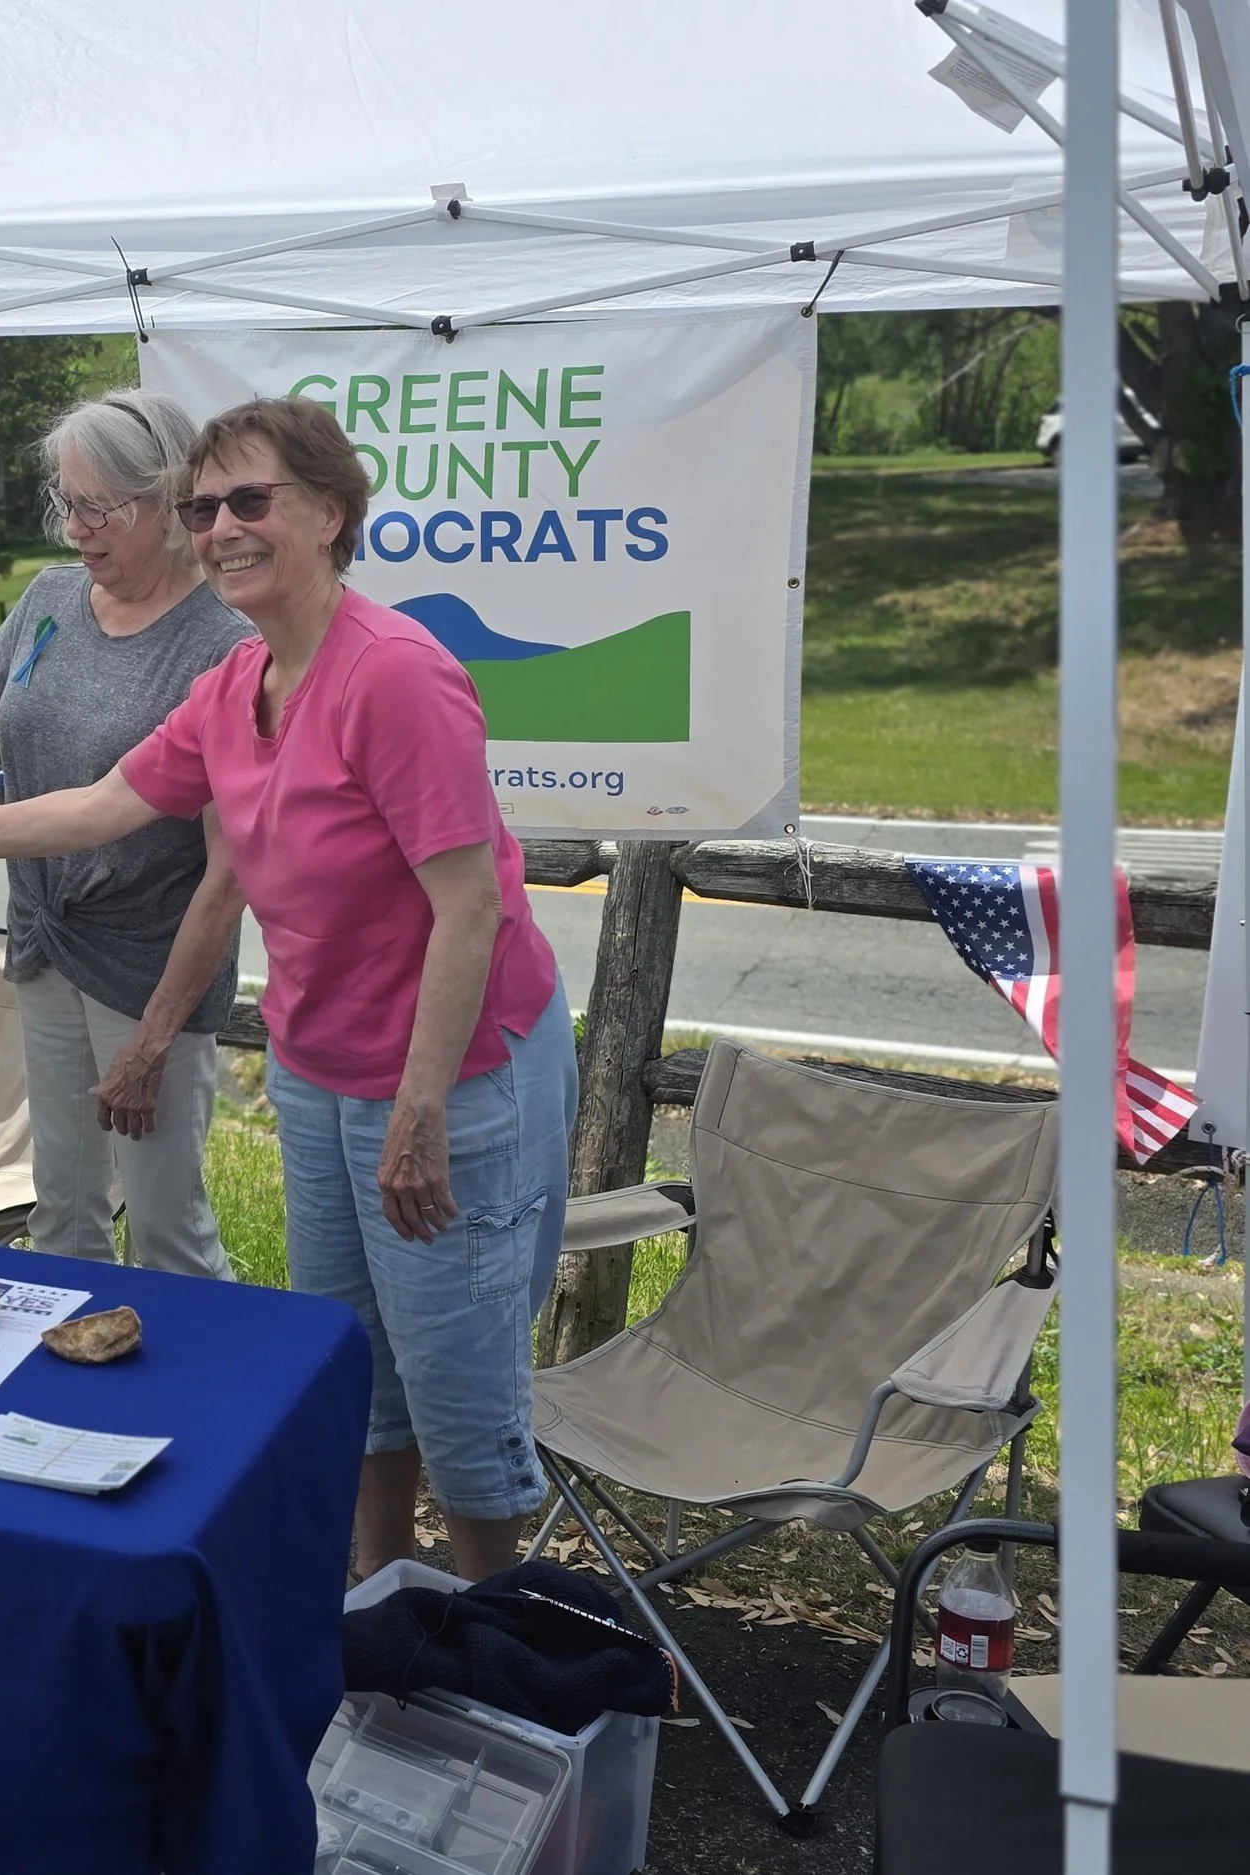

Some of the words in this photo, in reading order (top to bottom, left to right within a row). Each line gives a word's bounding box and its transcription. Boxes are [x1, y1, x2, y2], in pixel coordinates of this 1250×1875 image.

[354, 439, 601, 501] OUNTY
[352, 506, 669, 563] OCRATS
[488, 766, 625, 797] rats.org
